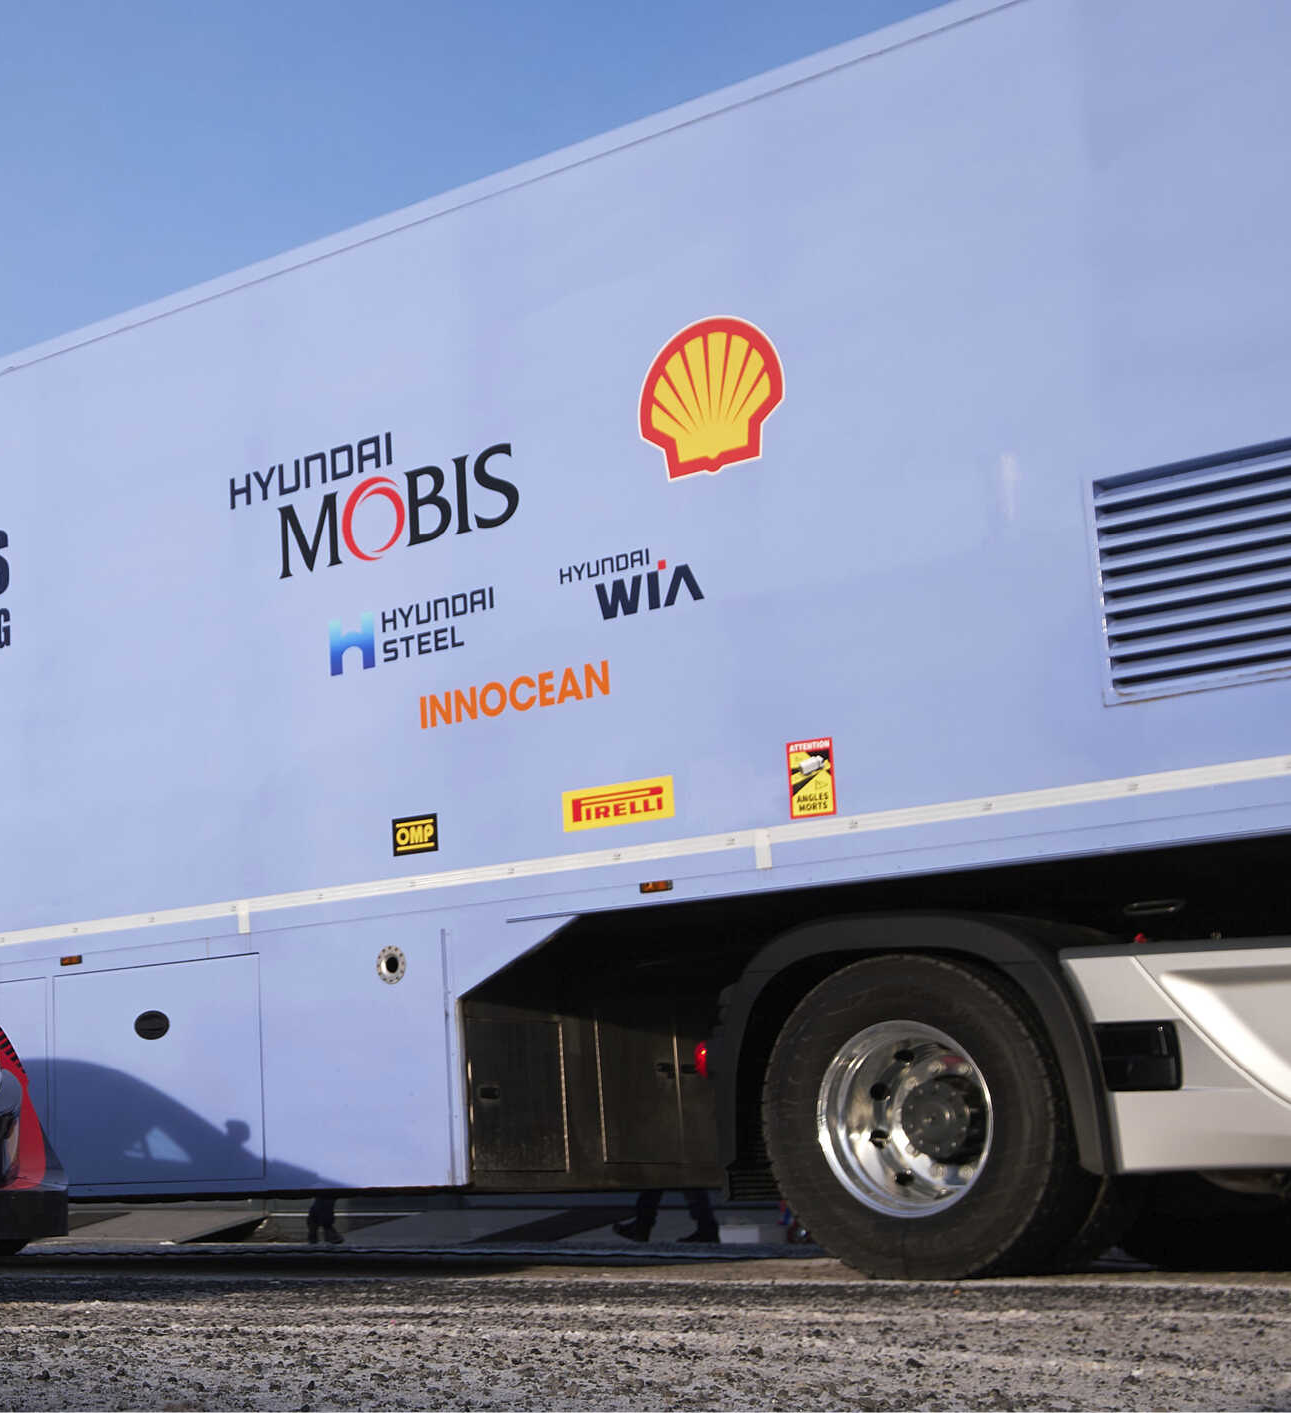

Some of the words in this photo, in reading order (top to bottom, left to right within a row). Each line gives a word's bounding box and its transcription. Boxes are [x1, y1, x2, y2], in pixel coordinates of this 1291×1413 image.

[230, 431, 393, 510] HYUNDAI
[277, 443, 520, 580] MOBIS
[560, 548, 650, 585] HYUNDAI
[595, 559, 705, 621] WIA
[381, 586, 494, 633] HYUNDAI
[383, 626, 465, 663] STEEL
[419, 660, 610, 729] INNOCEAN
[789, 740, 830, 752] ATTENTION
[571, 786, 664, 823] PIRELLI
[797, 792, 829, 803] ANGLES
[799, 801, 828, 811] MORTS
[395, 823, 435, 846] OMP
